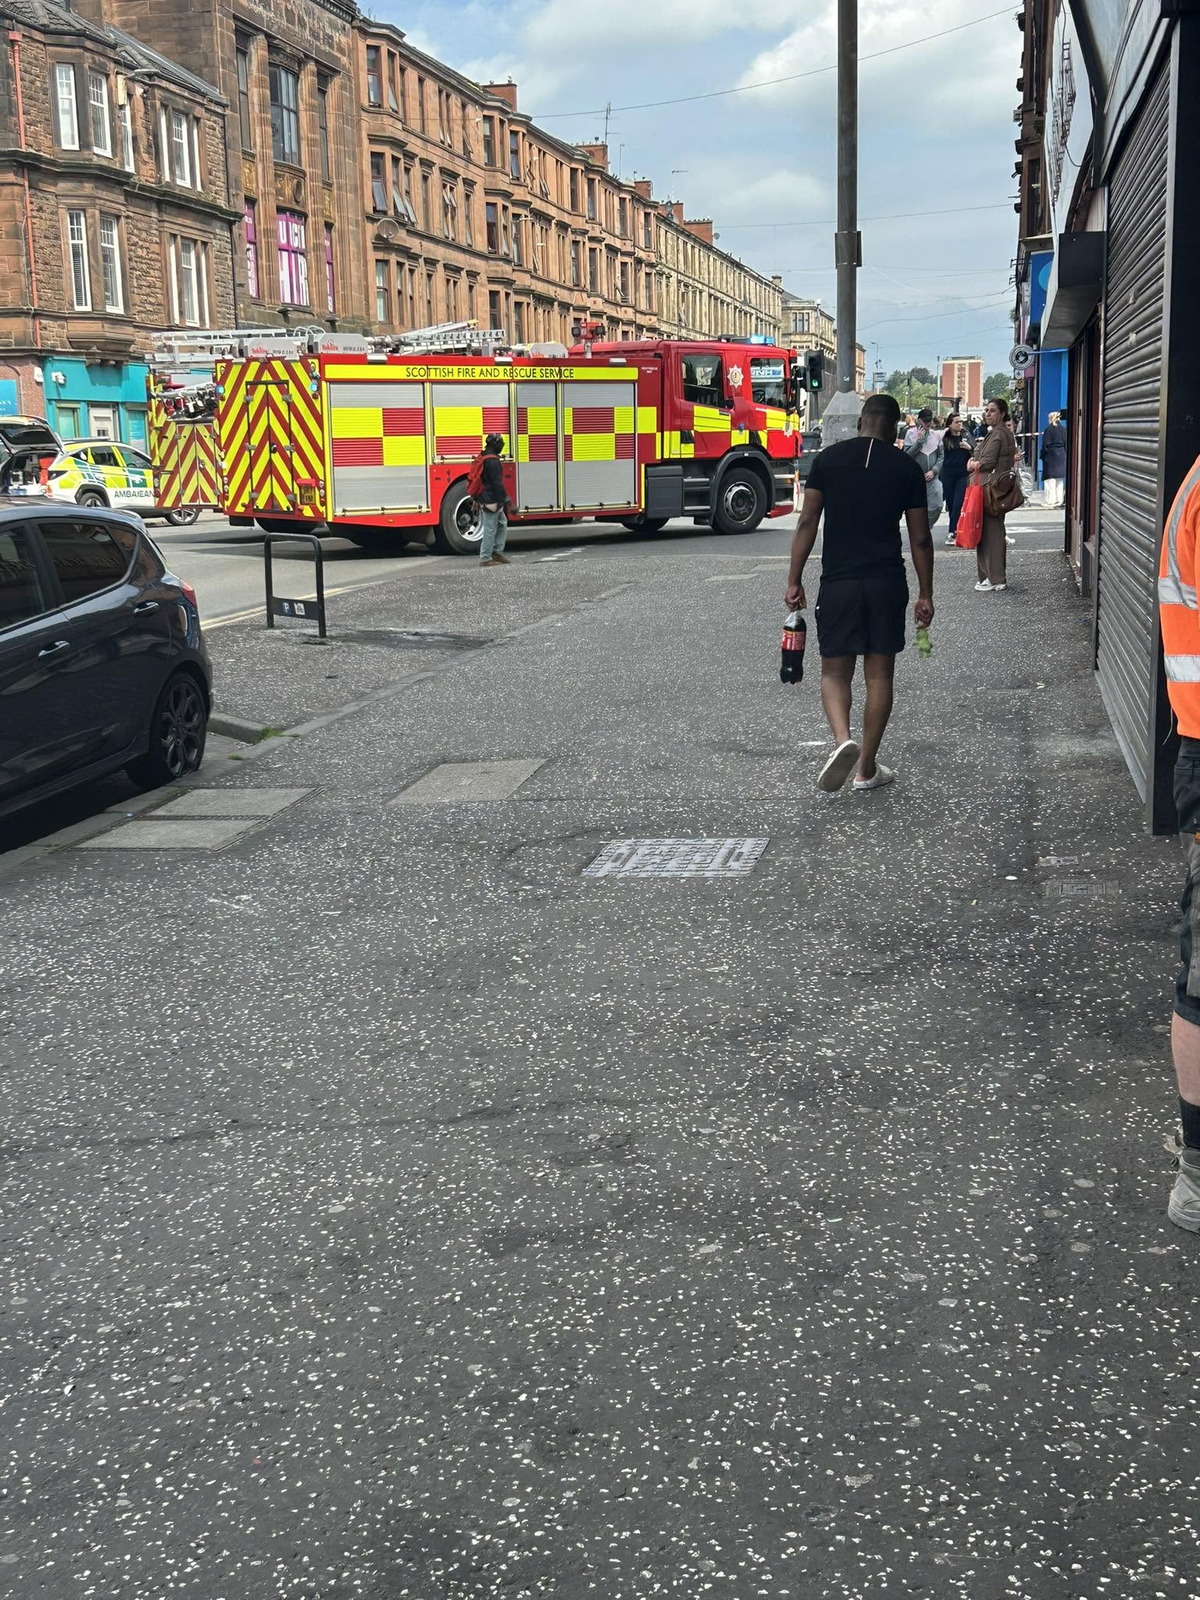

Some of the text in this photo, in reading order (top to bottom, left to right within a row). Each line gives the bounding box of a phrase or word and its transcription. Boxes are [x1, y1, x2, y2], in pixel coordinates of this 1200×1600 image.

[406, 367, 574, 378] SCOTTISH FIRE AND RESCUE SERVICE
